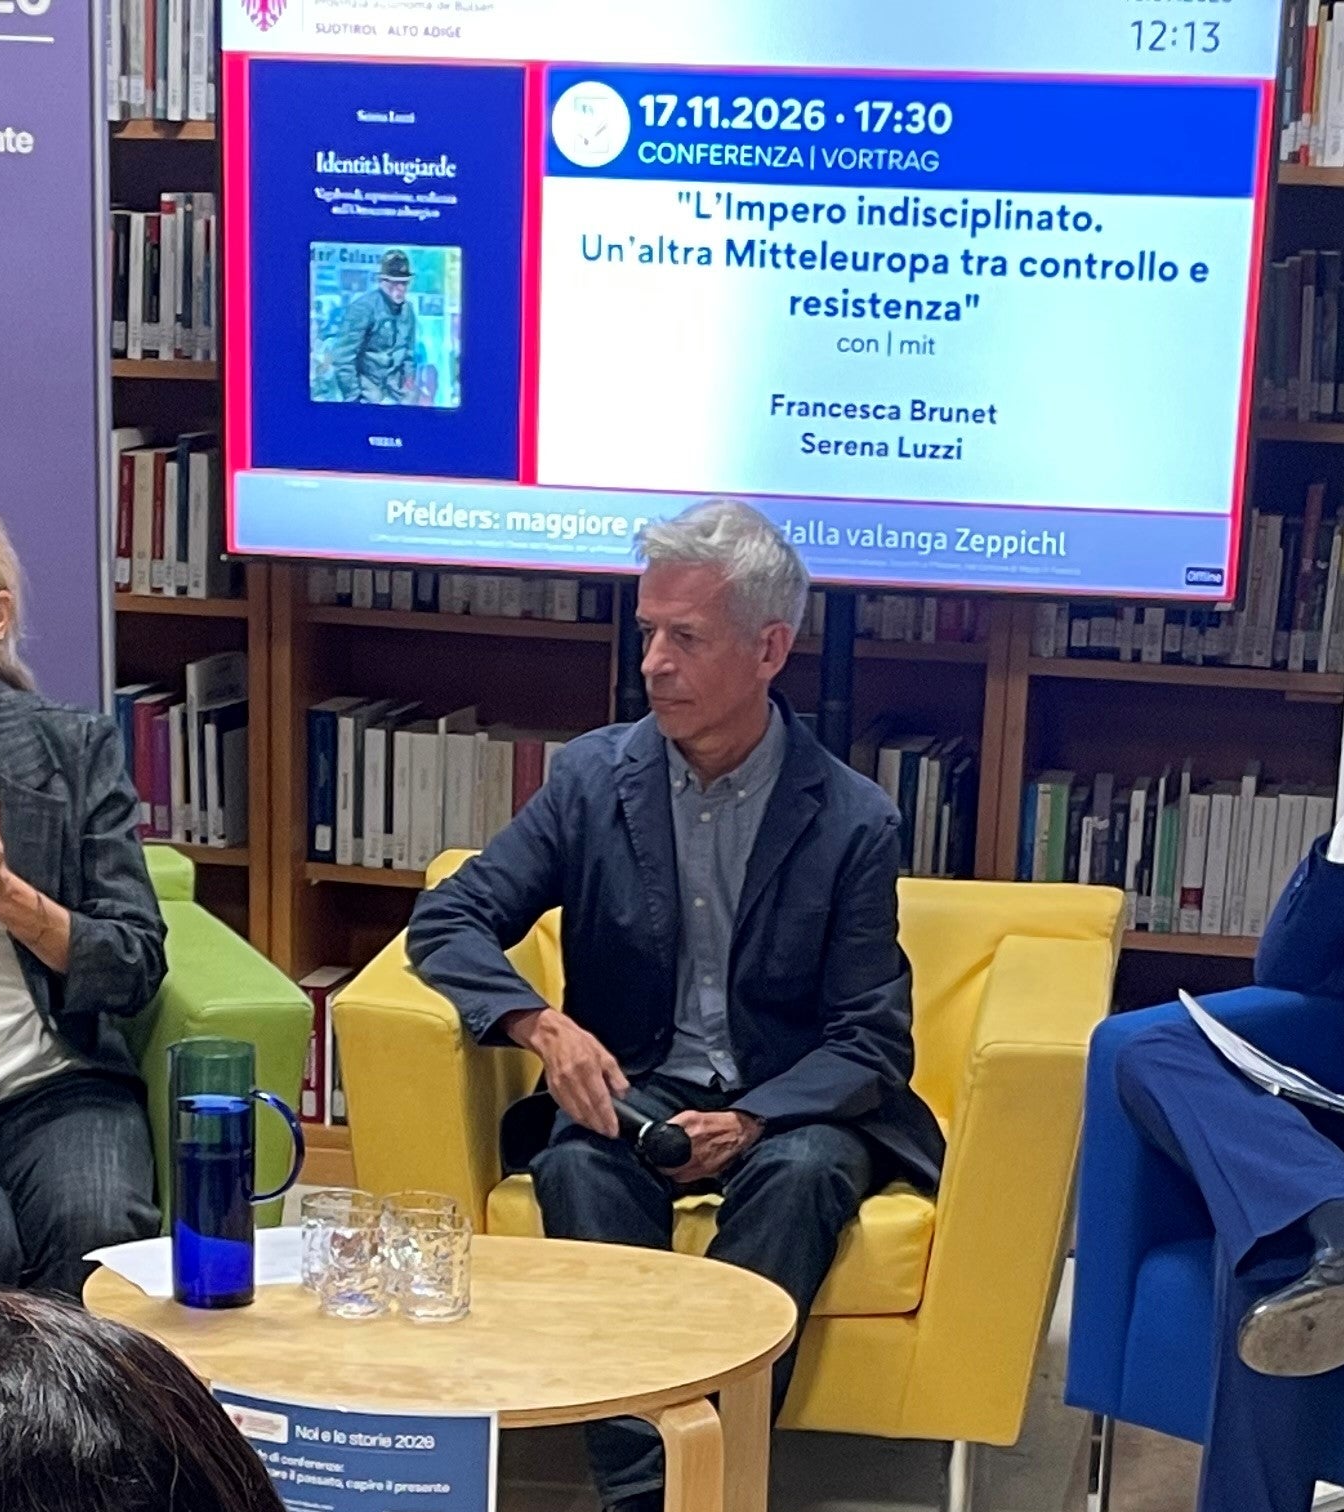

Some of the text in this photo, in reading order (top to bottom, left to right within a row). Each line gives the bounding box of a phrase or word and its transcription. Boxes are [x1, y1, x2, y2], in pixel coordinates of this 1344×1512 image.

[1131, 20, 1220, 52] 12:13
[638, 93, 952, 137] 17.11.2026 17:30
[316, 150, 456, 183] Identità bugiarde
[638, 140, 939, 174] CONFERENZA VORTRAG
[856, 194, 1104, 235] indisciplinato.
[581, 234, 1210, 284] Un'altra Mitteleuropa tra controllo e
[789, 286, 981, 324] resistenza"
[837, 333, 936, 356] con mit
[770, 393, 997, 427] Francesca Brunet
[801, 431, 963, 461] Serena Luzzi
[387, 500, 500, 529] Pfelders:
[506, 509, 627, 540] maggiore
[847, 527, 947, 552] valanga
[955, 527, 1067, 558] Zeppichl
